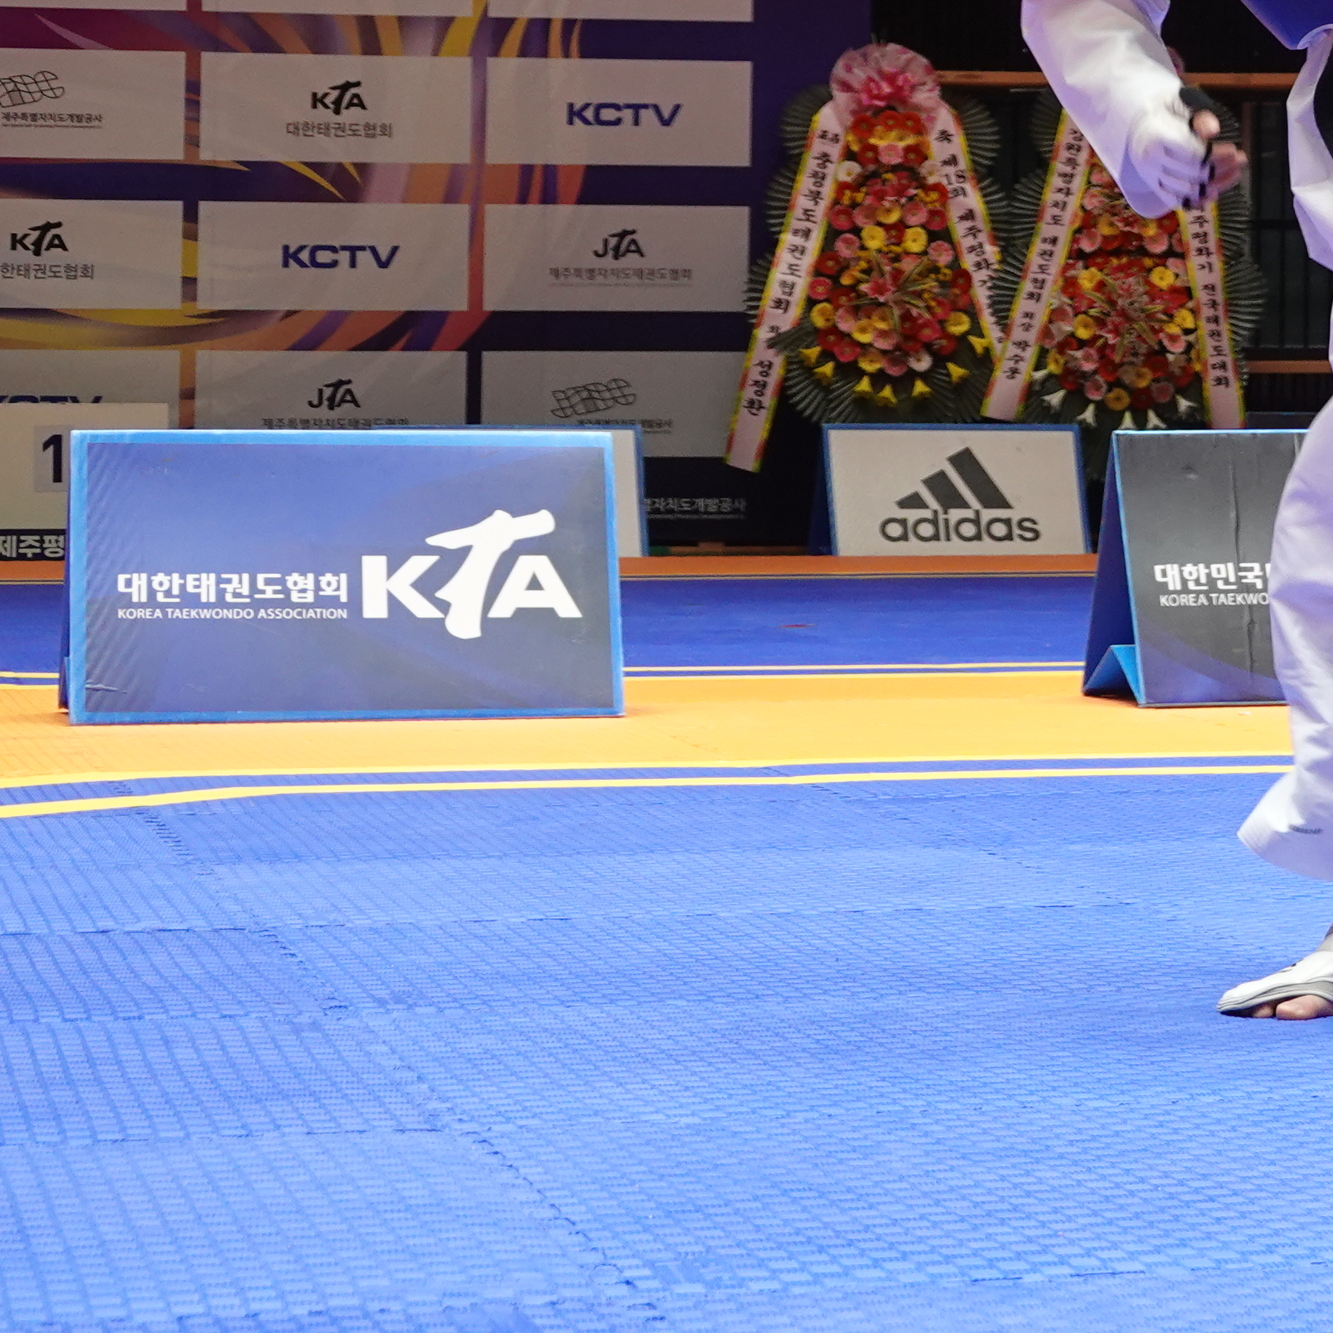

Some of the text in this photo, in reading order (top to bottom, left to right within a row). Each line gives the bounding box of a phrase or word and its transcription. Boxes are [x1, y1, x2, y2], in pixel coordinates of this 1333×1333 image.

[310, 80, 368, 116] KTA
[566, 102, 682, 127] KCTV
[285, 121, 393, 139] 대한태권도협회
[10, 221, 69, 257] KTA
[592, 228, 646, 261] JTA
[281, 245, 400, 269] KCTV
[308, 379, 362, 411] JTA
[643, 497, 747, 512] 자치도개발공사
[879, 508, 1042, 543] adidas
[0, 534, 65, 558] 제주평
[117, 572, 349, 604] 대한태권도협회
[361, 509, 584, 640] KTA
[1153, 561, 1272, 591] 대한민국
[117, 608, 348, 620] KOREA TAEKWONDO ASSOCIATION
[1159, 592, 1270, 607] KOREA TAEKWO
